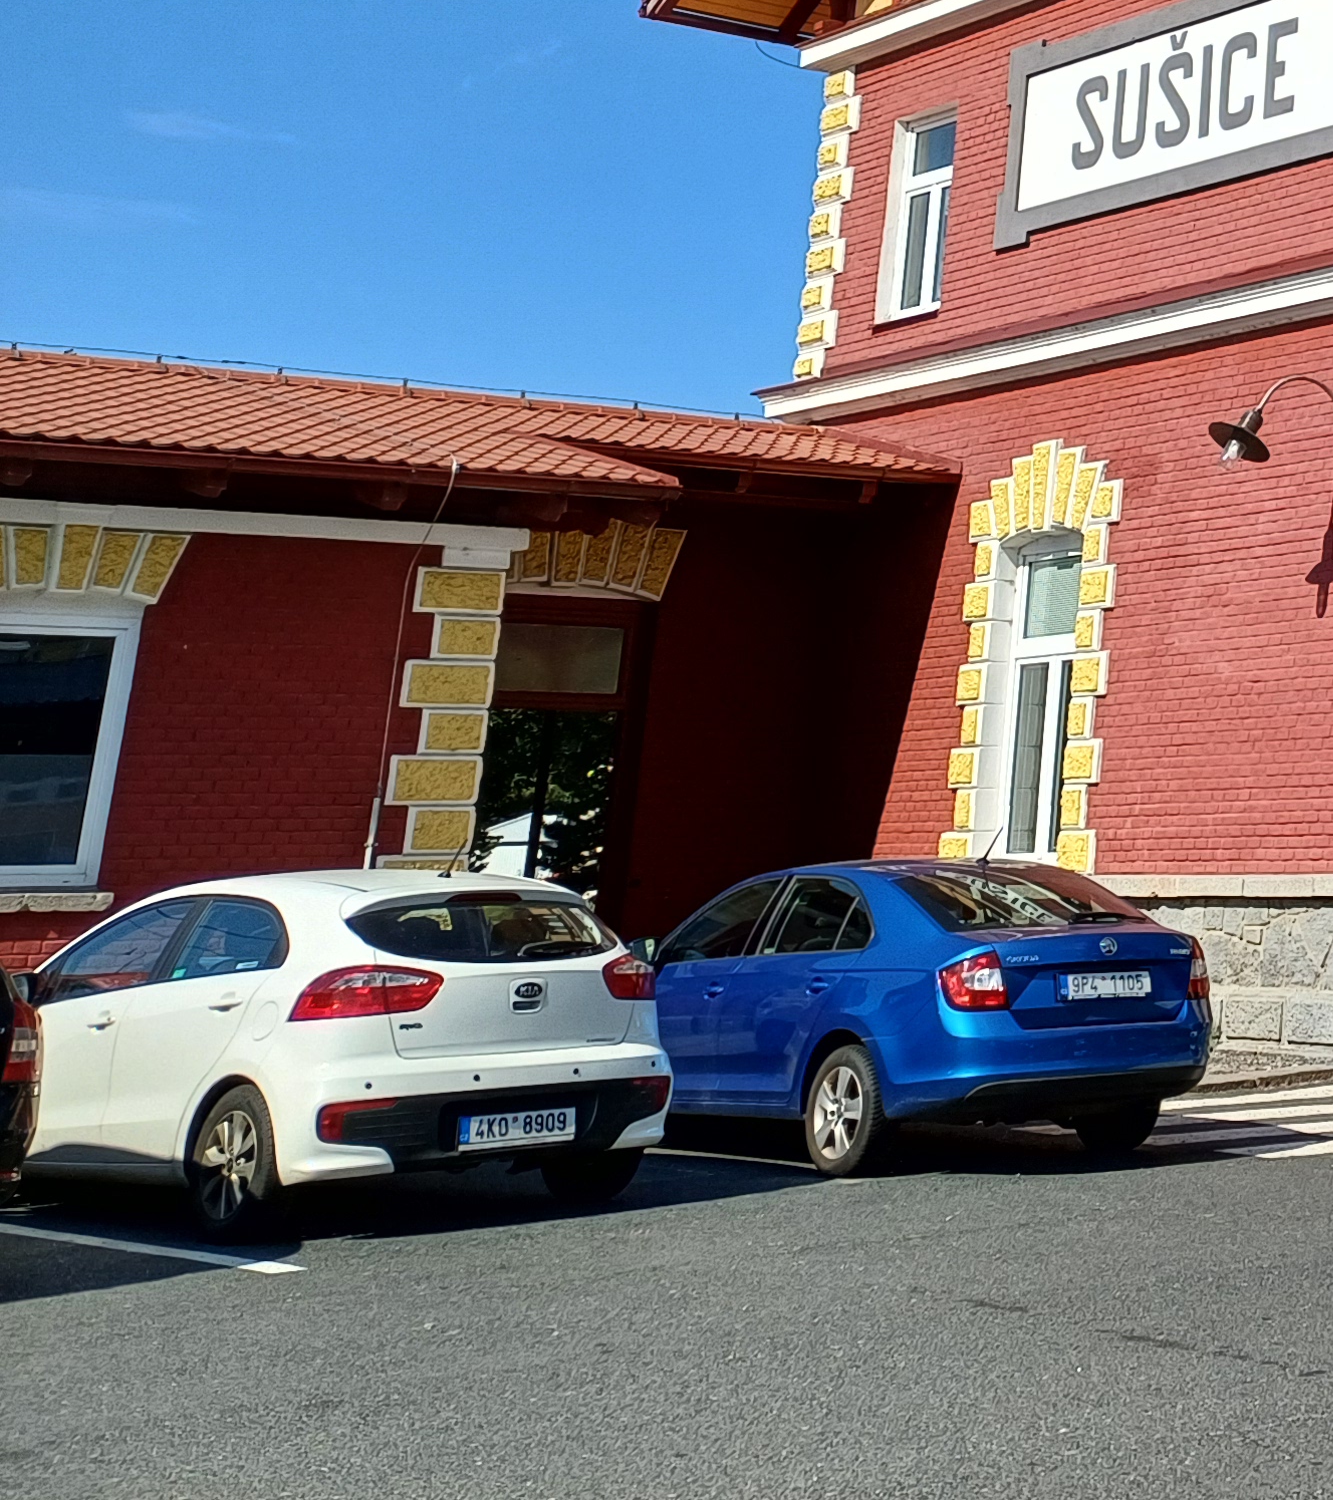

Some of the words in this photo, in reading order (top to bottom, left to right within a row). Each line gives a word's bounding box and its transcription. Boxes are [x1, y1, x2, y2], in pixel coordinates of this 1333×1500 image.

[1071, 16, 1299, 170] SUŠICE
[519, 985, 539, 996] KIA
[1072, 976, 1098, 994] 9P4
[1110, 973, 1144, 994] 1105
[523, 1111, 567, 1135] 8909
